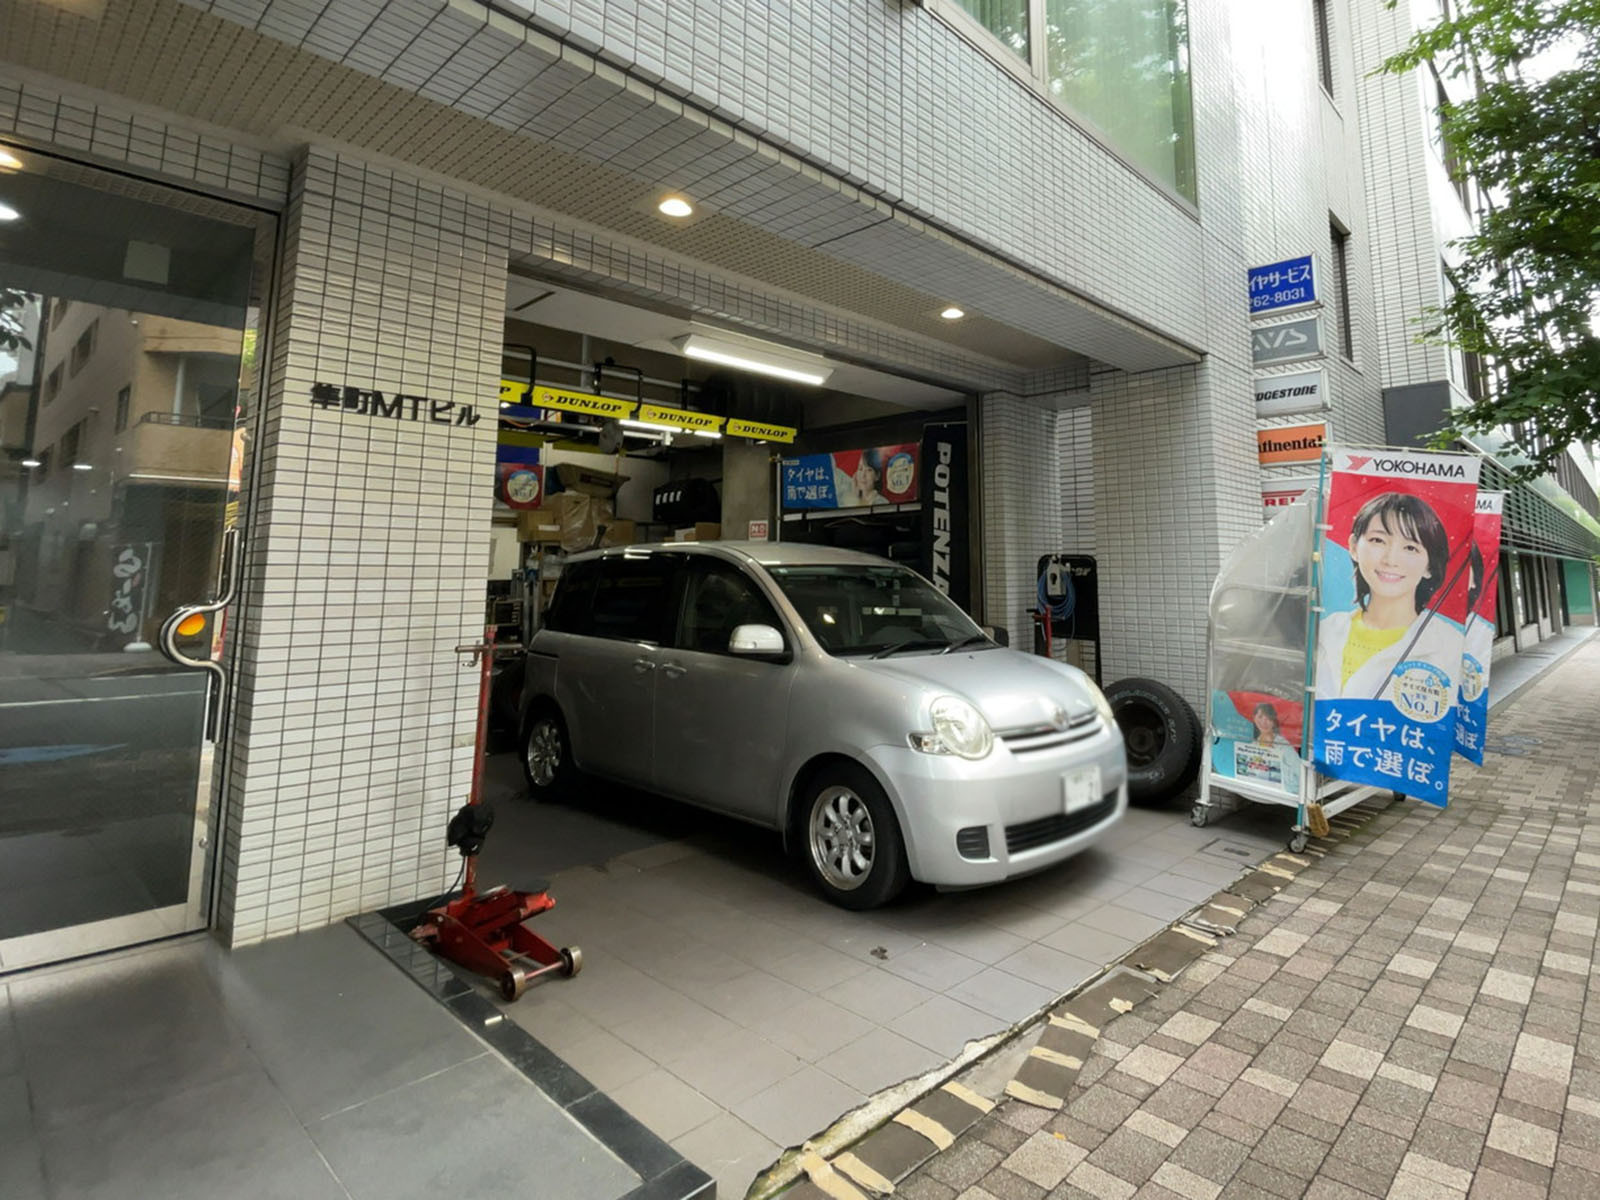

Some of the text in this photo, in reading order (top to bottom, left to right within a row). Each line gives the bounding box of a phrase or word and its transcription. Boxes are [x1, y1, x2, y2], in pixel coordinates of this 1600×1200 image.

[1255, 384, 1318, 402] DGESTONE
[555, 395, 622, 413] DUNLOP
[658, 412, 713, 427] DUNLOP
[742, 425, 788, 438] DUNLOP
[1373, 458, 1465, 478] YOKOHAMA
[1400, 691, 1442, 717] No.1
[1325, 708, 1436, 756] タイヤは、
[1324, 739, 1444, 791] 雨で選ぼ。
